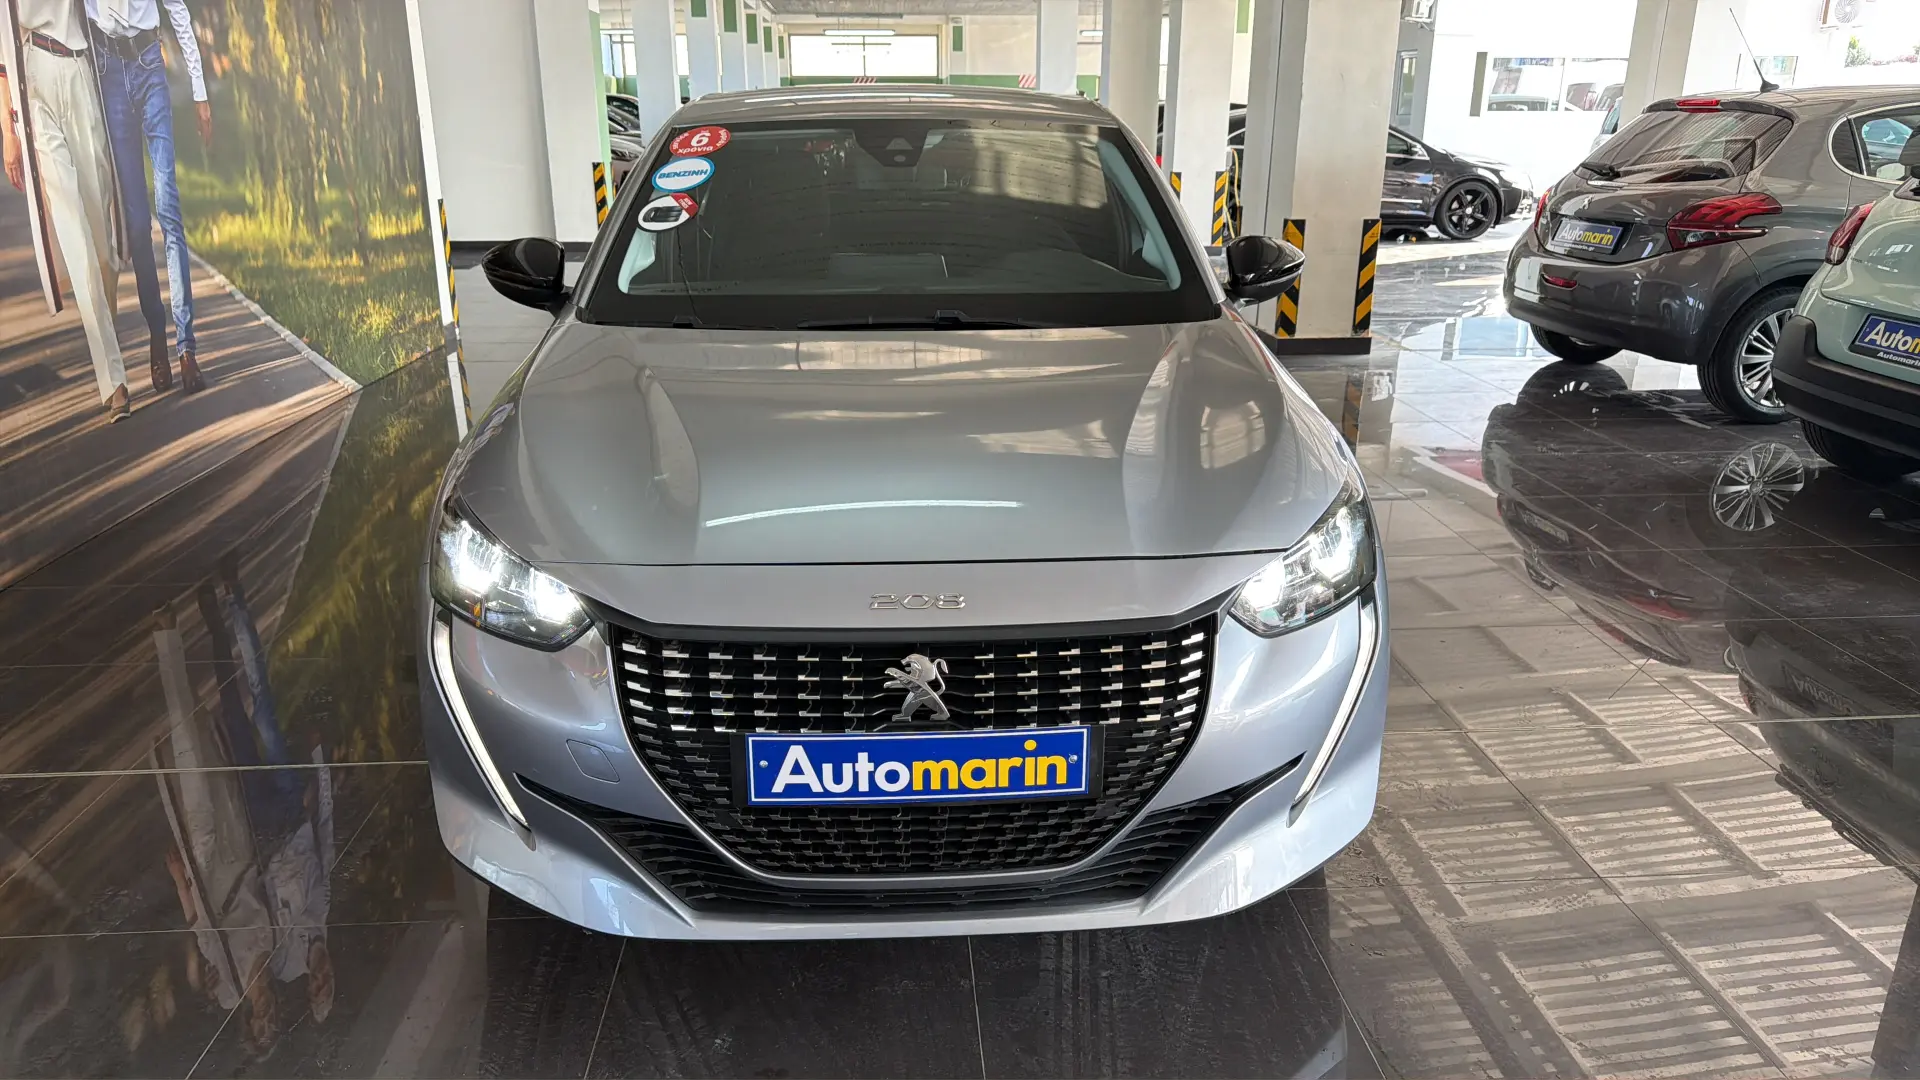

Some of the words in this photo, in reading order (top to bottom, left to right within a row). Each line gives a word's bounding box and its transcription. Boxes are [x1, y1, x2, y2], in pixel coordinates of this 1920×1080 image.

[691, 132, 711, 147] 6
[1559, 224, 1614, 245] Automarin
[869, 592, 966, 610] 208
[771, 739, 1068, 793] Automarin
